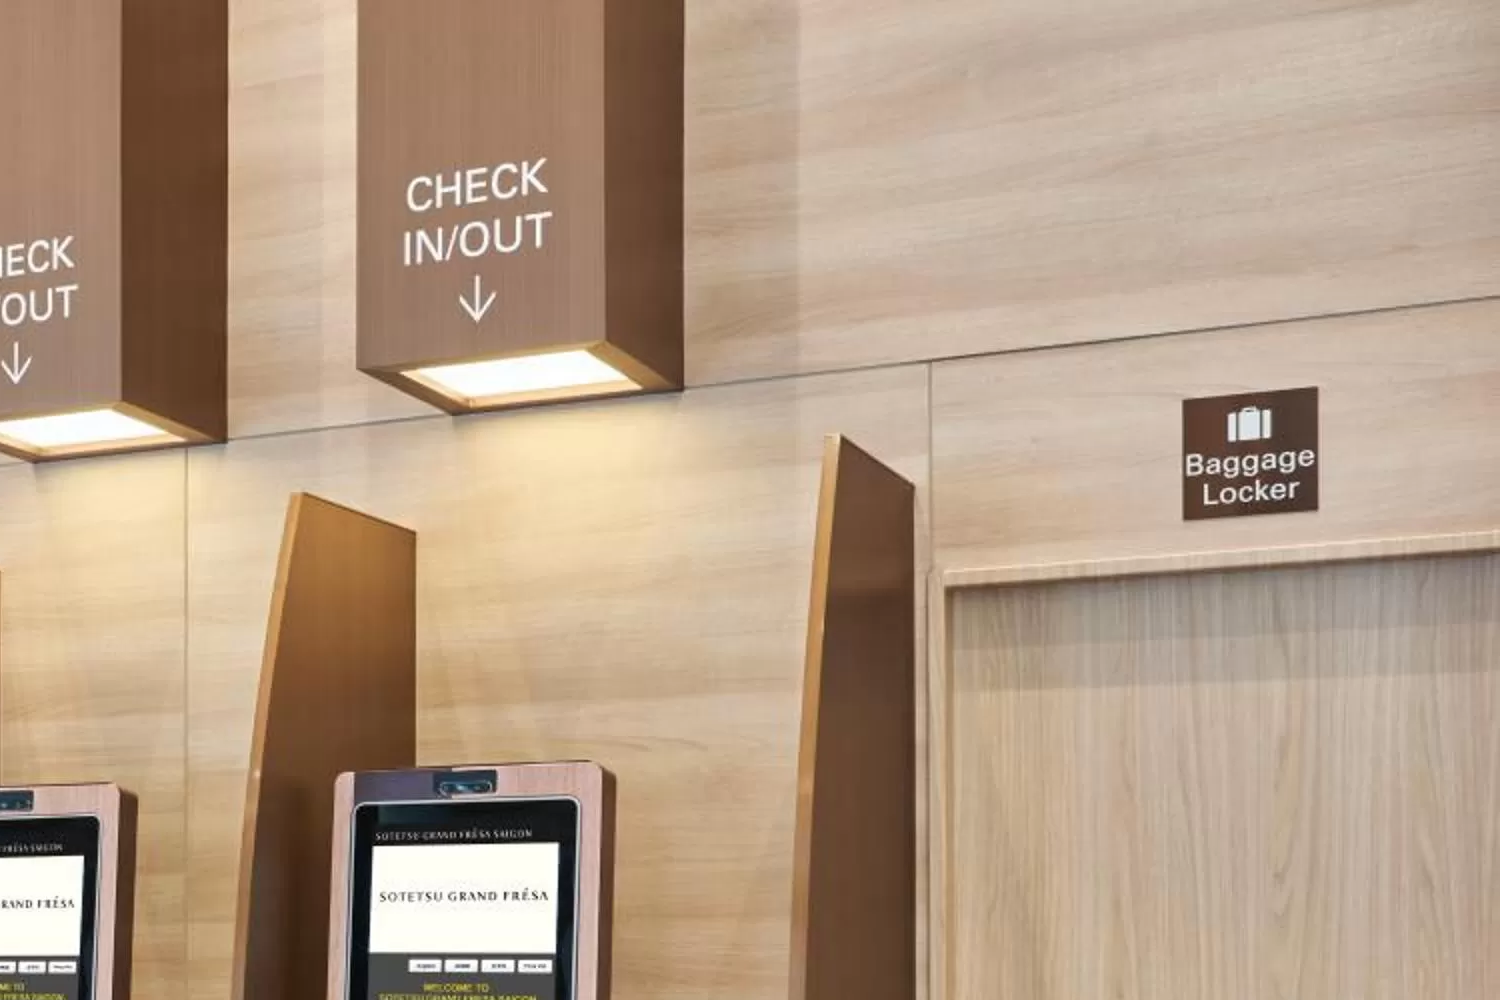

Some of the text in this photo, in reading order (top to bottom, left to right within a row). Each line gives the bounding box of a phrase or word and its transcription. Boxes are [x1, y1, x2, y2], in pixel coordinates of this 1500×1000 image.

[407, 157, 548, 213] CHECK
[404, 211, 553, 266] IN/OUT
[1186, 450, 1315, 478] Baggage
[1204, 480, 1300, 505] Locker
[379, 891, 443, 903] SOTETSU
[447, 891, 498, 901] GRAND
